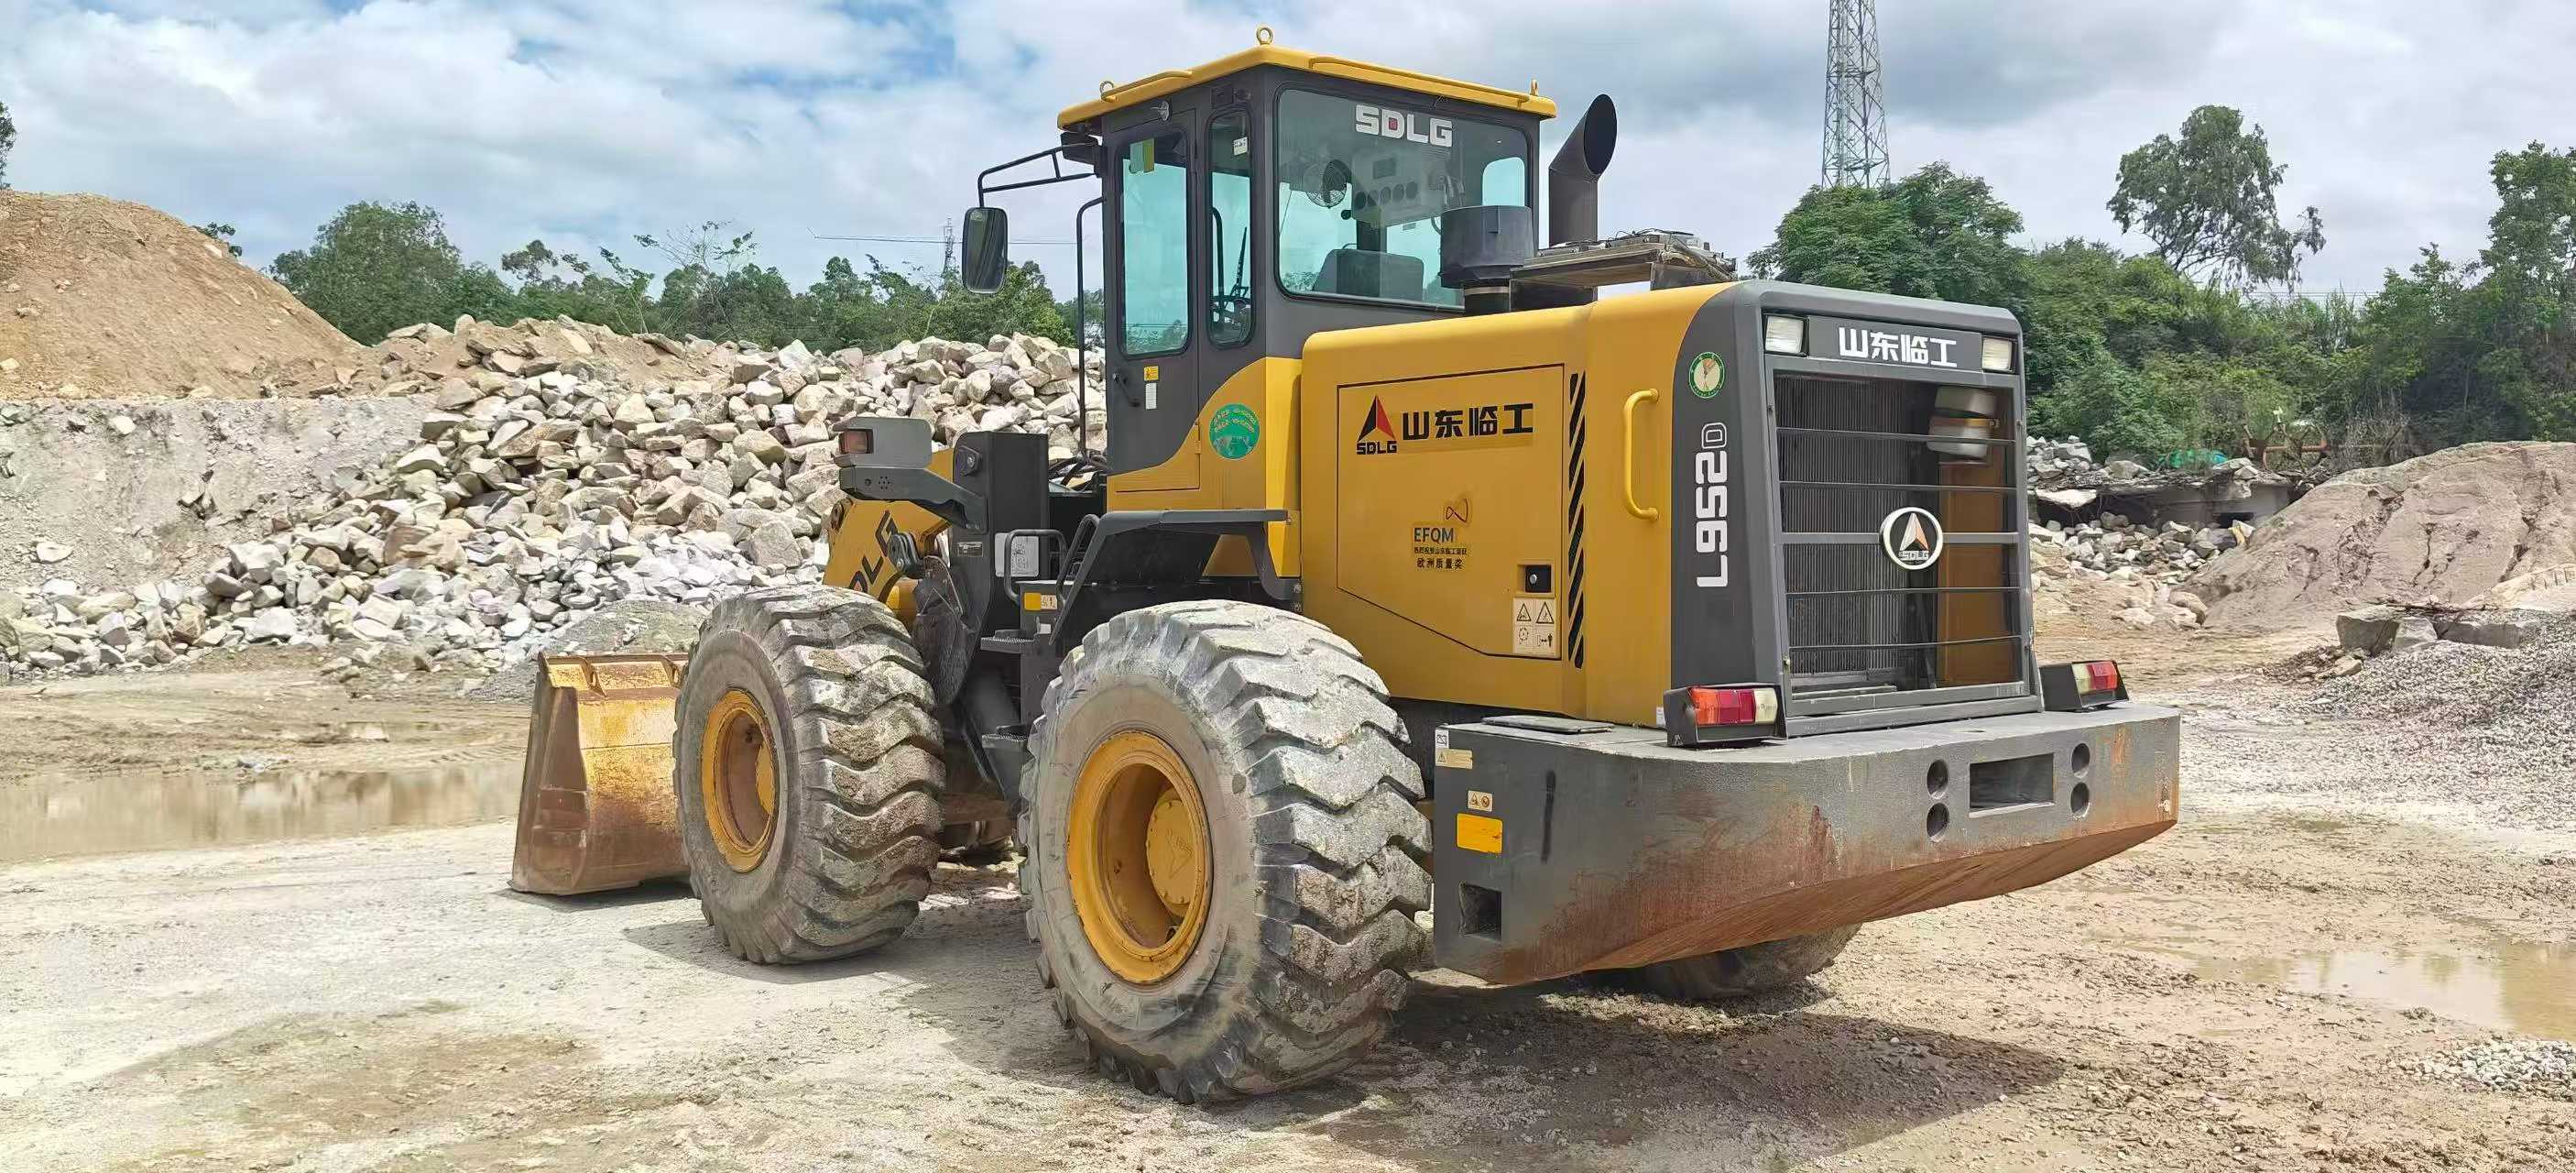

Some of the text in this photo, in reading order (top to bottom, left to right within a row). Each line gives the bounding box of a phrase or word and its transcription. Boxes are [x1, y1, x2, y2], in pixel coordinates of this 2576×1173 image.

[1356, 104, 1453, 148] SDLG
[1839, 327, 1958, 367] 山东临工
[1403, 403, 1534, 440] 山东临工
[1356, 440, 1398, 455] SDLG
[1695, 422, 1729, 587] L952D
[848, 510, 898, 594] DLG
[1414, 527, 1454, 543] EFQM
[1416, 557, 1463, 570] 欧洲质量奖
